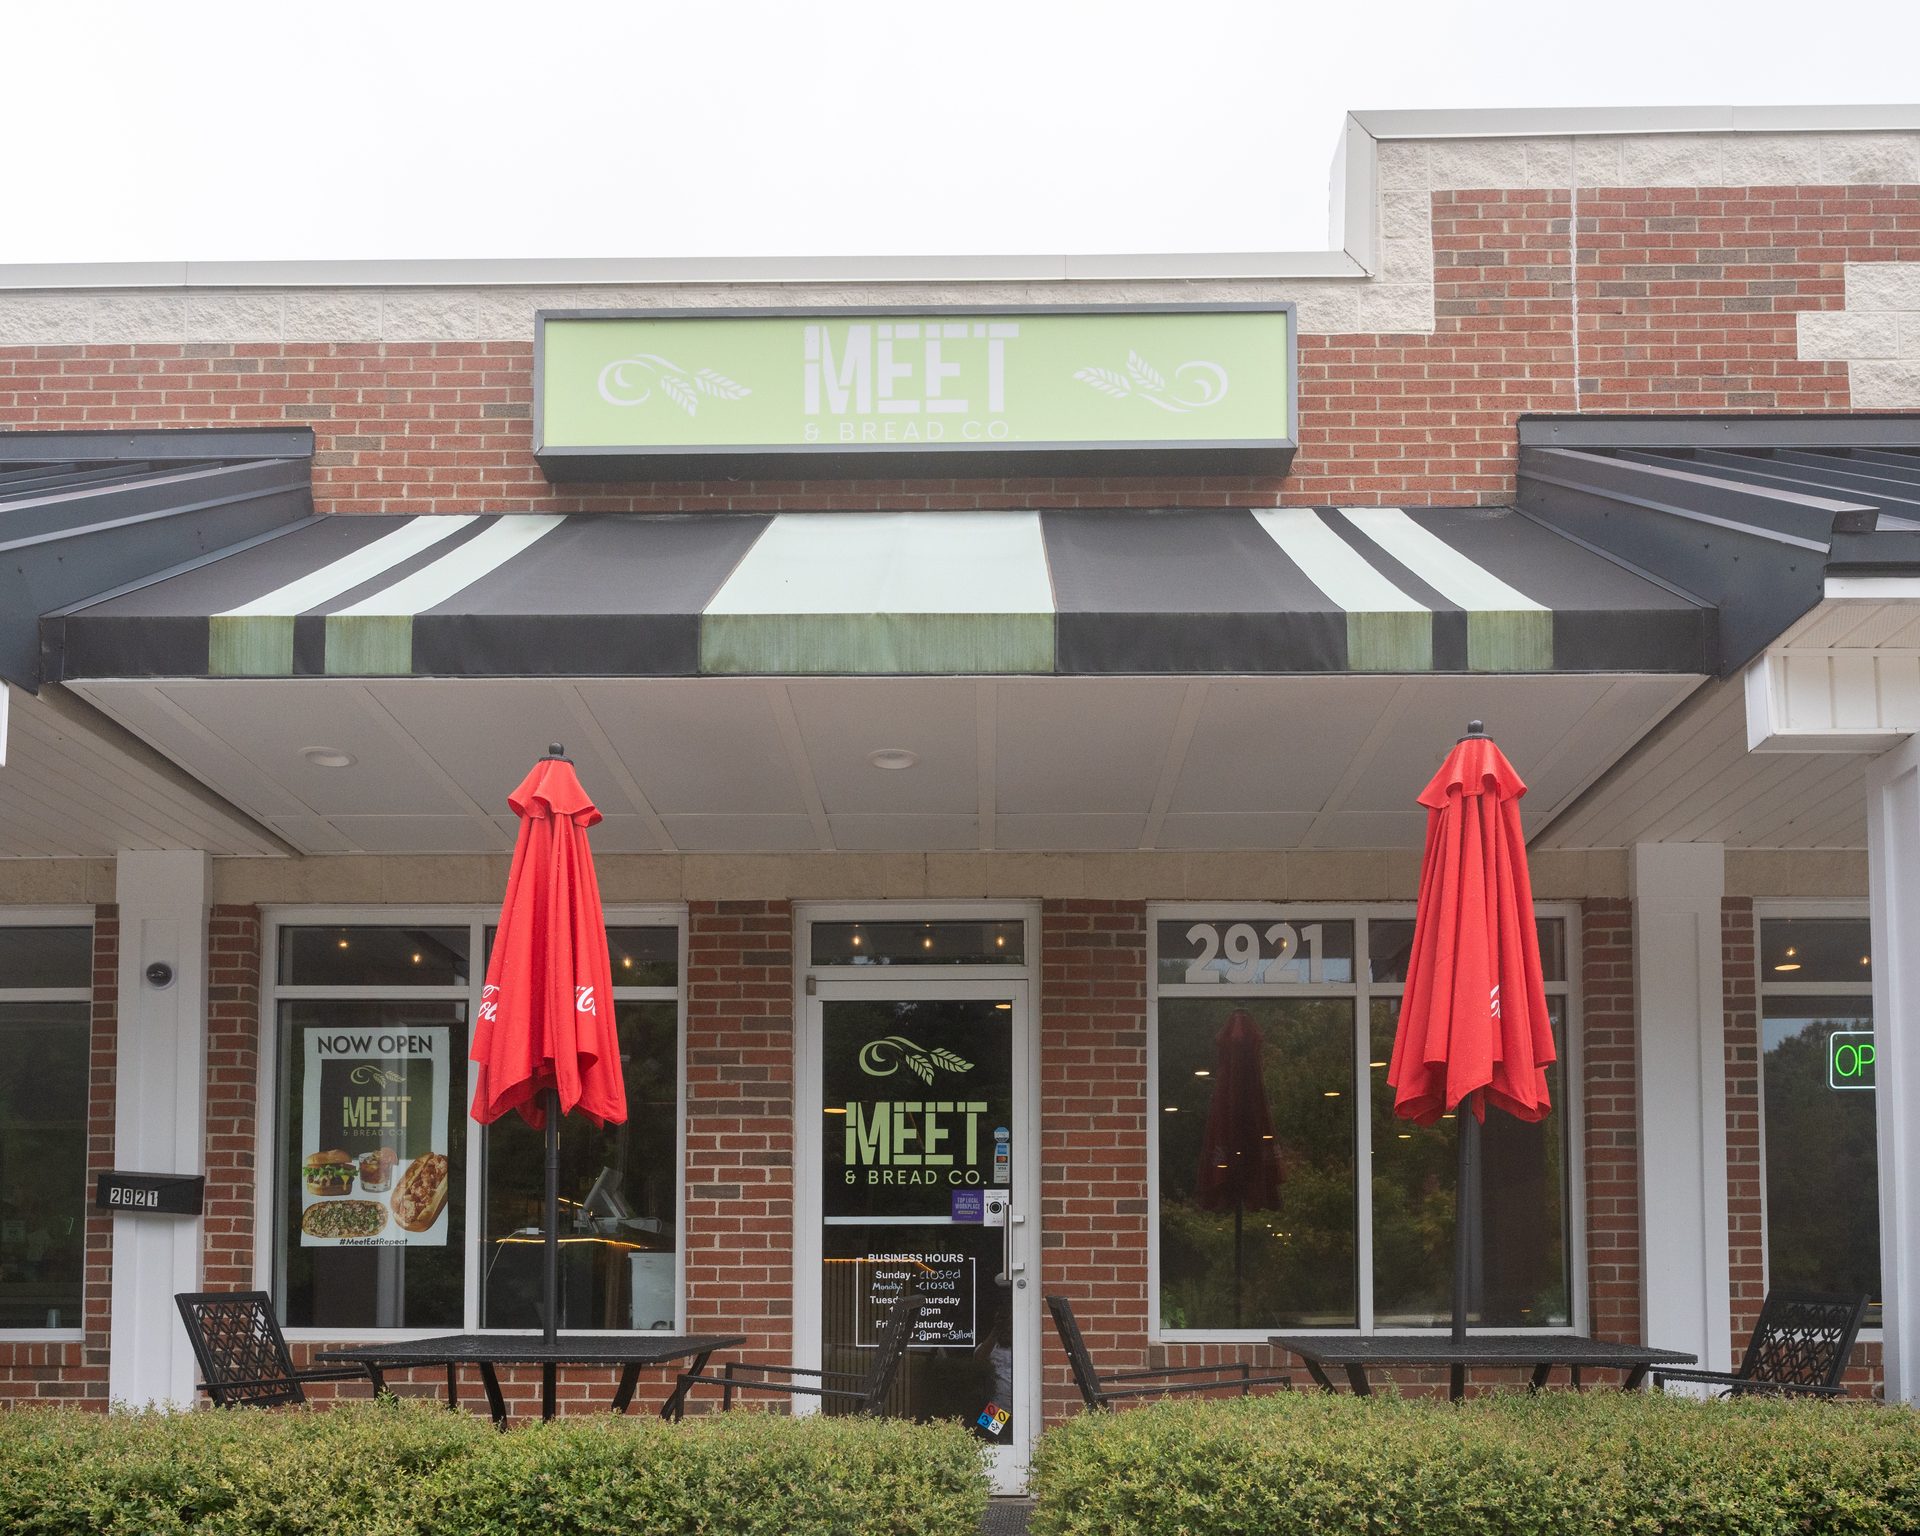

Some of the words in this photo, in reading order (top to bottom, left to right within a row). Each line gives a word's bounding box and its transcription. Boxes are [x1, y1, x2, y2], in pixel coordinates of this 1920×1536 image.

[804, 323, 1020, 416] MEET
[804, 422, 821, 441] &
[839, 421, 944, 441] BREAD
[962, 420, 1021, 440] CO.
[1184, 923, 1323, 984] 2921
[318, 1035, 373, 1054] NOW
[377, 1034, 433, 1054] OPEN
[1835, 1044, 1875, 1077] OP
[343, 1096, 412, 1128] MEET
[845, 1101, 988, 1165] MEET
[845, 1170, 857, 1185] &
[868, 1170, 938, 1185] BREAD
[948, 1170, 988, 1185] CO.
[111, 1188, 158, 1206] 2921
[339, 1237, 408, 1247] #MeetEatRepeat
[868, 1253, 923, 1263] BUSINESS
[925, 1253, 964, 1263] HOURS
[875, 1270, 911, 1281] Sunday
[870, 1296, 899, 1304] Tuesd
[981, 1414, 990, 1426] 3
[998, 1411, 1006, 1422] 0
